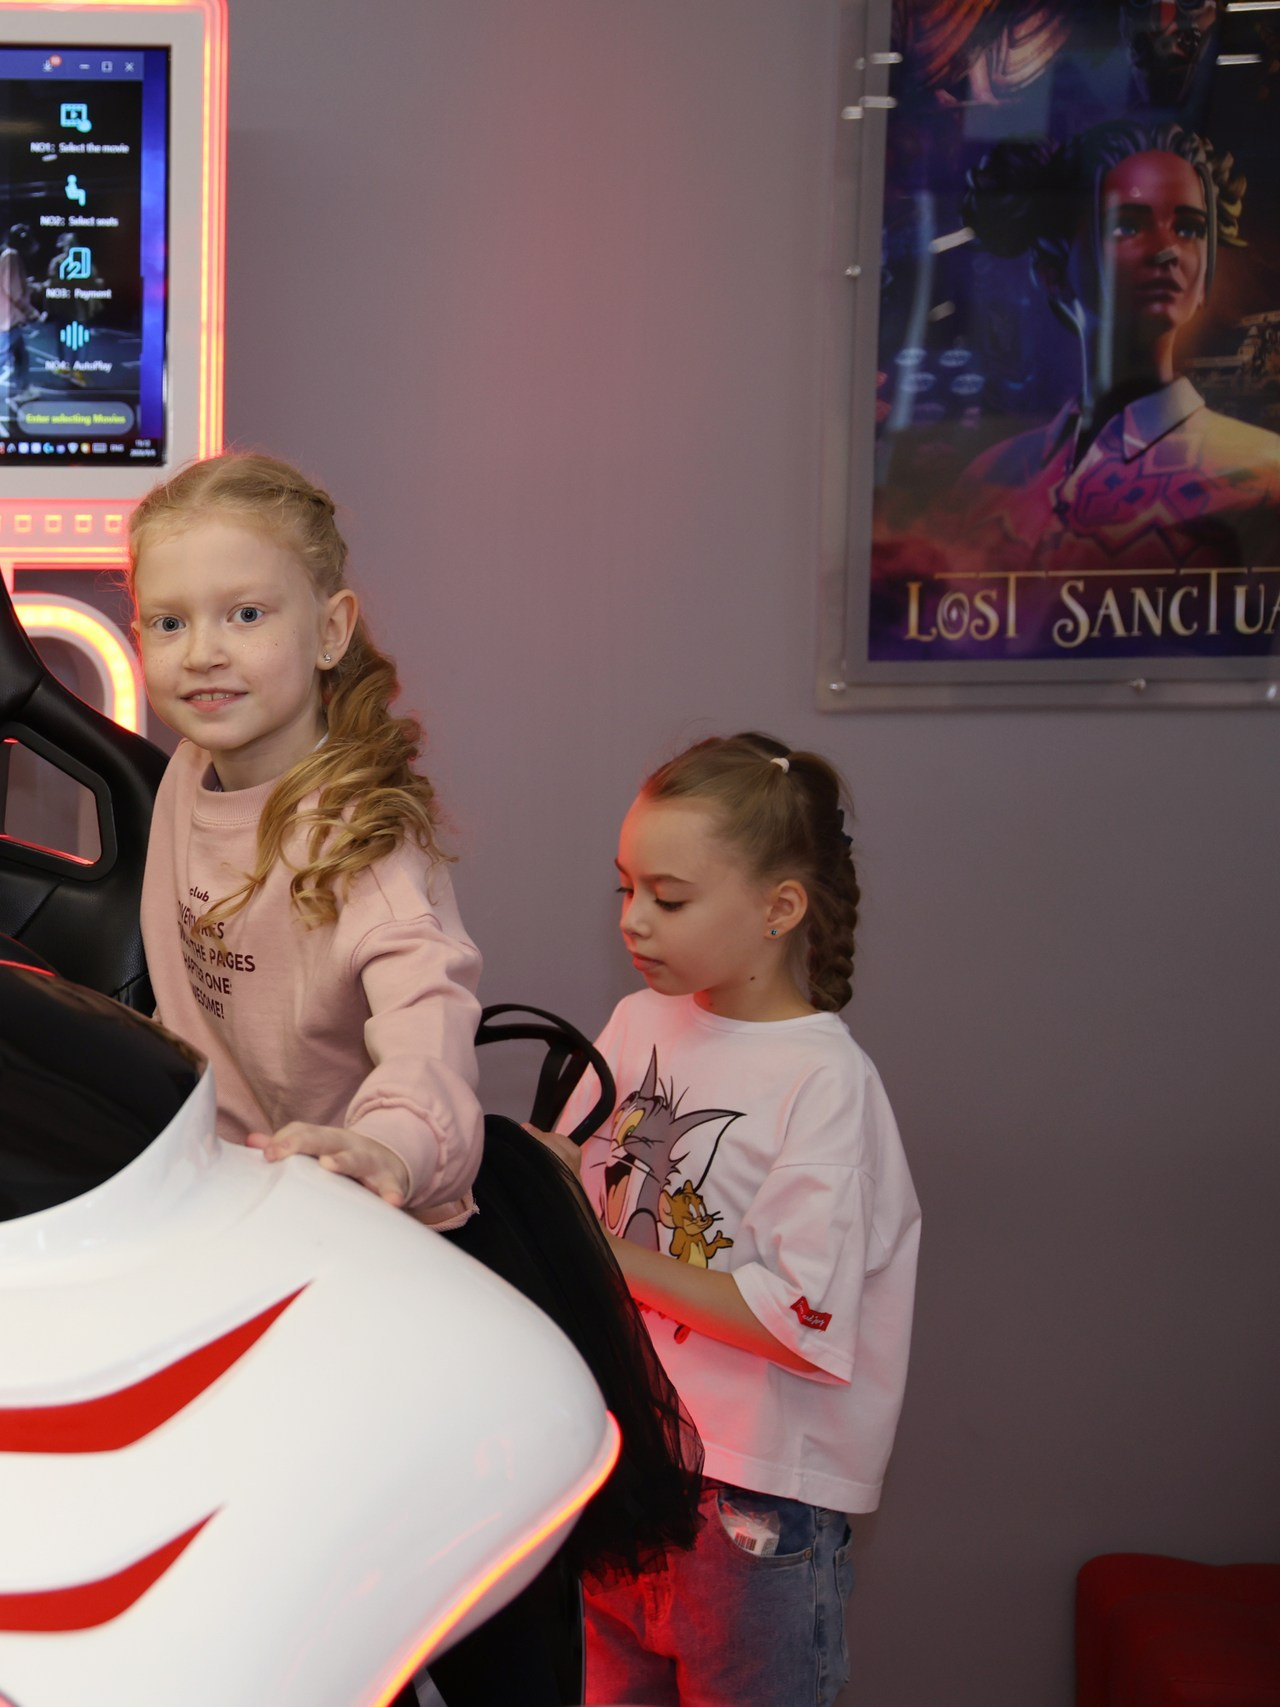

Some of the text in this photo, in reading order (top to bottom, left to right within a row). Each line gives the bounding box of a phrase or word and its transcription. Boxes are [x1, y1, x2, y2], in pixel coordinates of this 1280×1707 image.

[59, 142, 85, 153] Select
[86, 142, 101, 153] the
[102, 143, 130, 154] movie
[68, 215, 95, 227] Select
[74, 288, 112, 300] Payment
[26, 413, 126, 426] Enter selecting Movies
[904, 571, 1022, 642] LOST
[189, 886, 209, 902] club
[209, 947, 256, 973] PAGES
